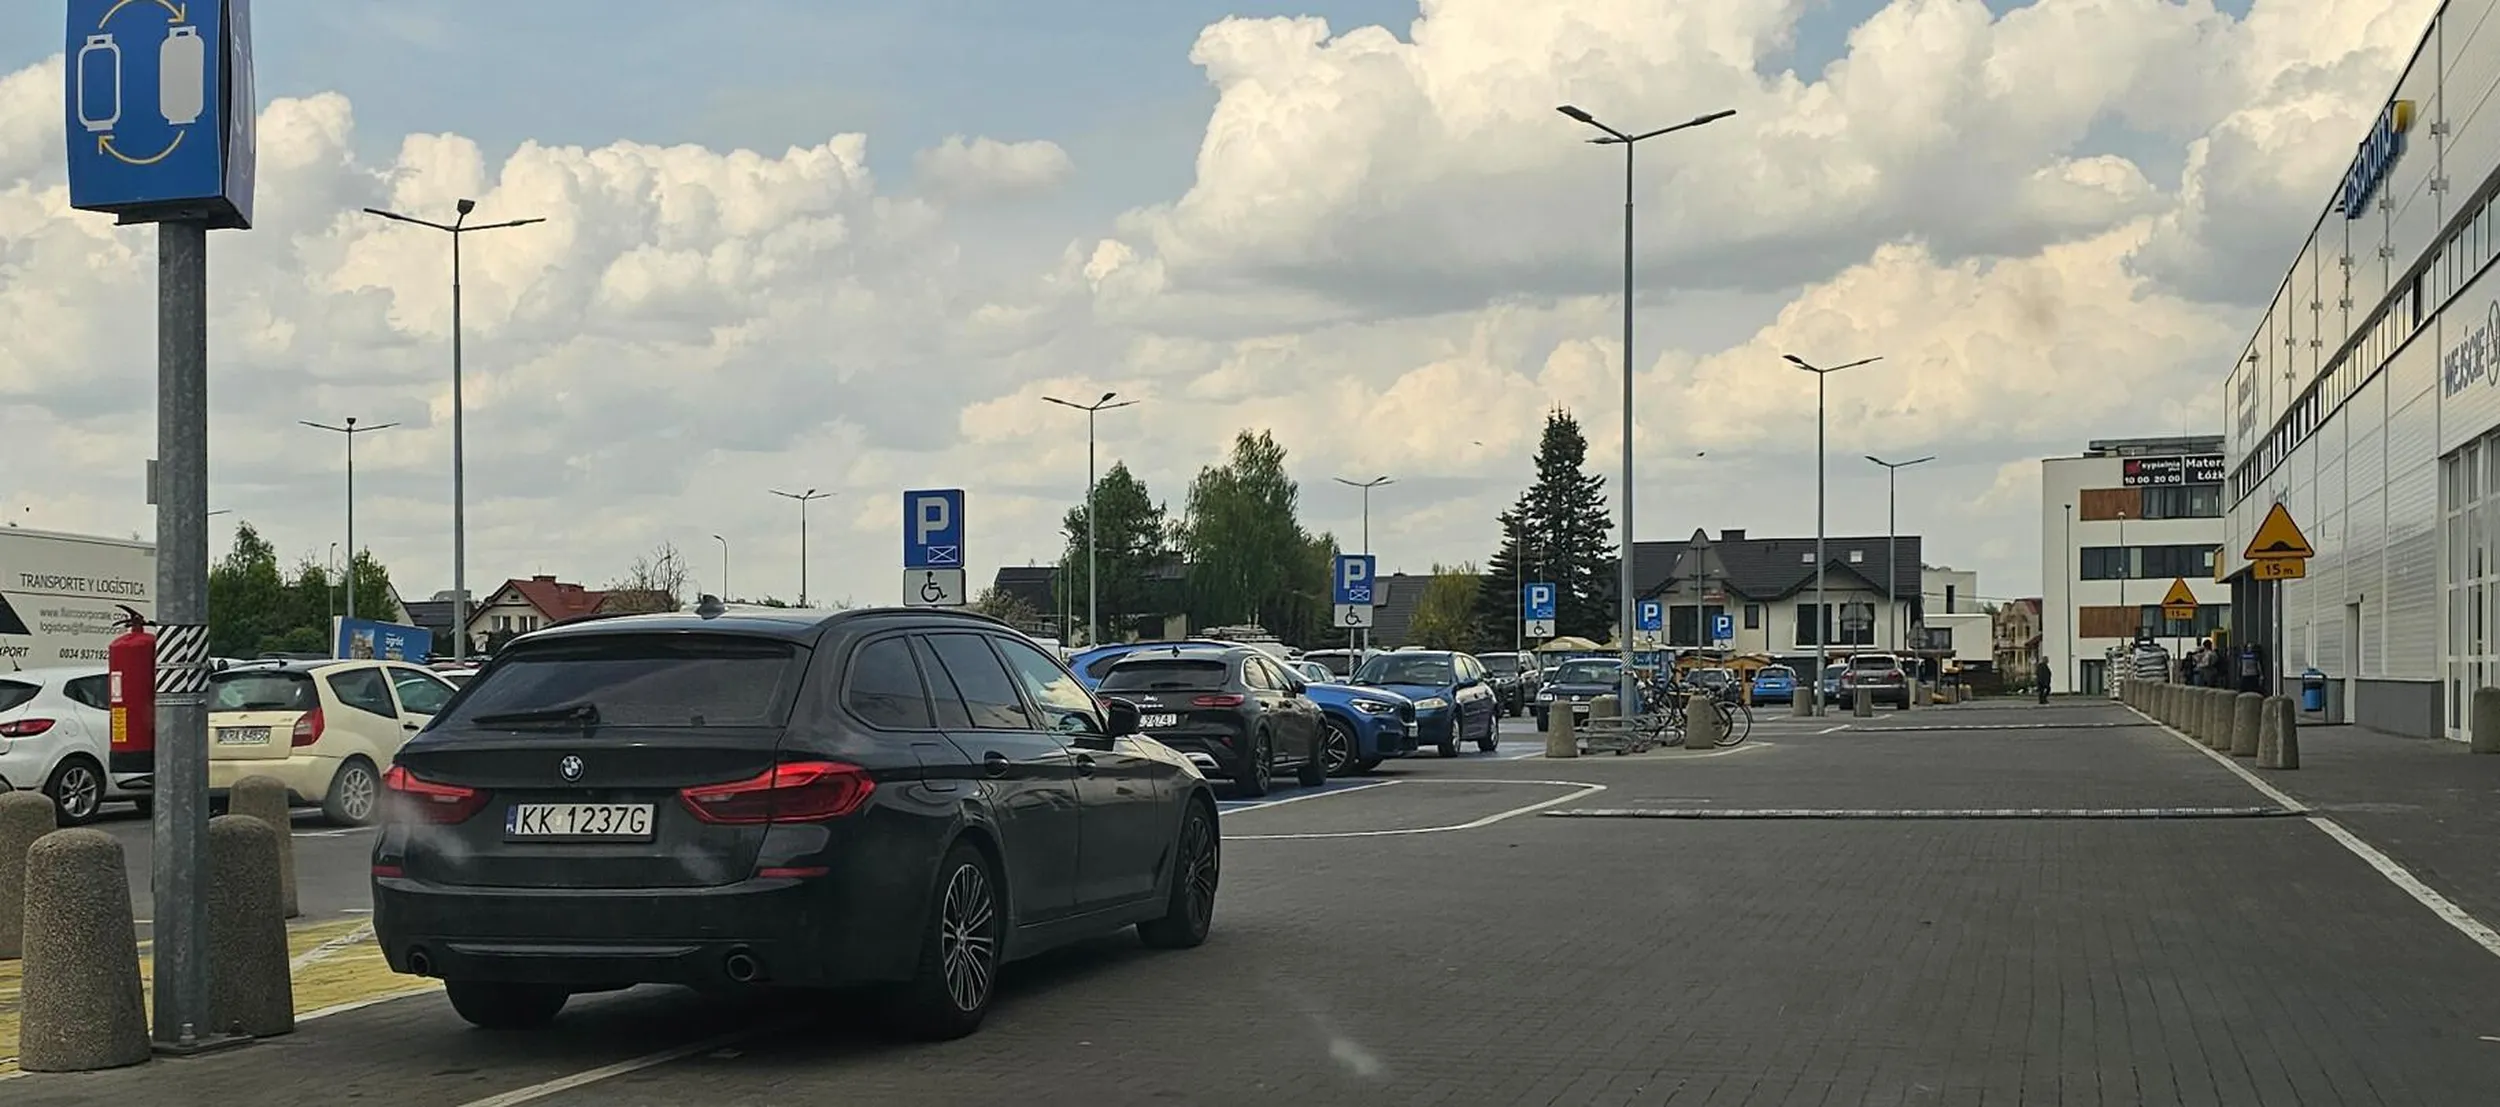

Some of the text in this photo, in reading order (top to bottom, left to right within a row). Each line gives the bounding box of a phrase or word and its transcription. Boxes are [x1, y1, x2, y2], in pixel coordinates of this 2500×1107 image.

[917, 497, 949, 544] P
[1344, 559, 1366, 589] P
[2265, 564, 2280, 575] 15
[20, 573, 145, 596] TRANSPORTE Y LOGÍSTICA
[1532, 587, 1549, 609] P
[1644, 604, 1658, 622] P
[1717, 617, 1729, 632] P
[521, 807, 646, 833] KK 1237G
